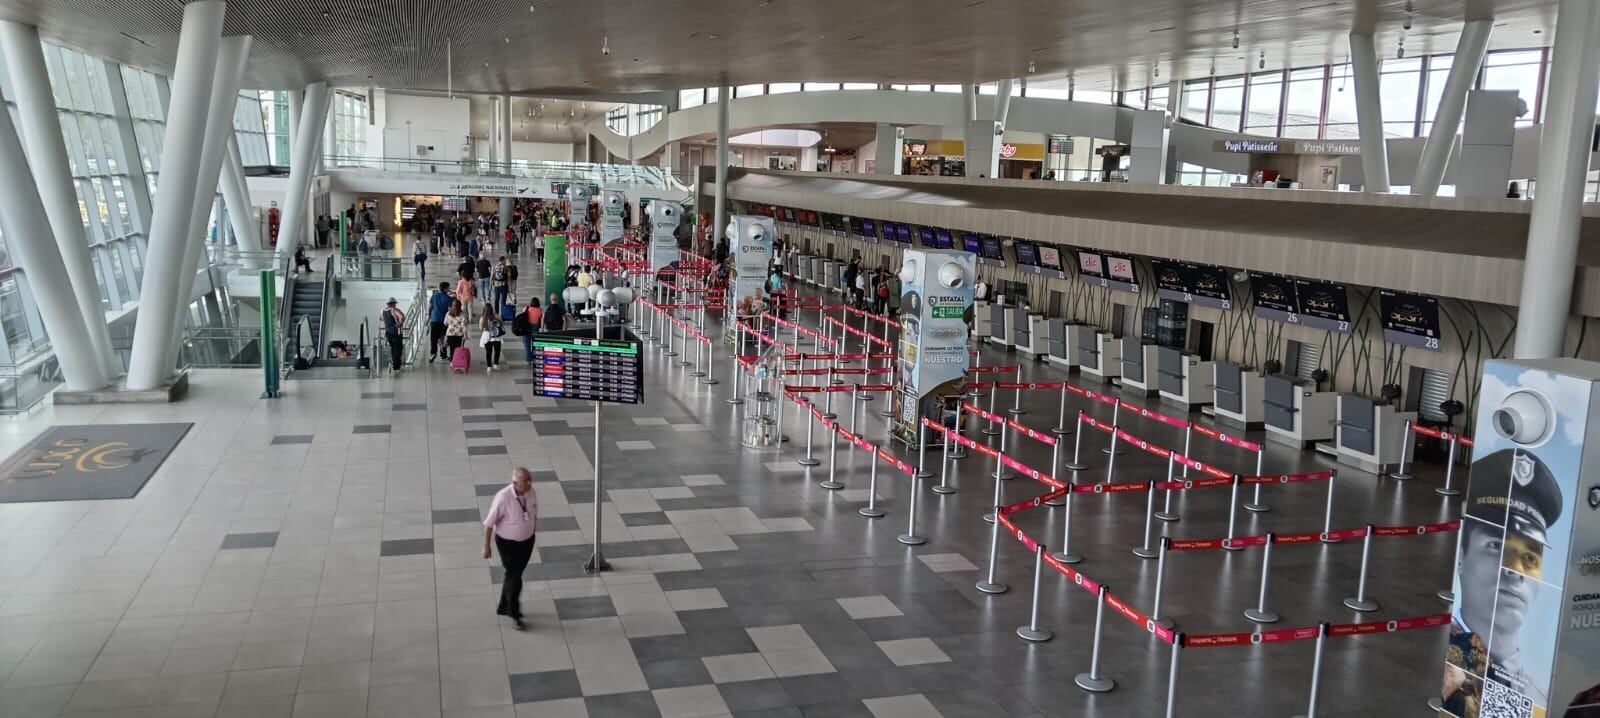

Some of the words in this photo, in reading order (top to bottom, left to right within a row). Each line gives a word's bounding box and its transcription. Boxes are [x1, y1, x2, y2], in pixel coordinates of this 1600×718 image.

[1225, 140, 1241, 152] Pupi
[1303, 143, 1325, 154] Pupi
[1085, 257, 1097, 267] clic
[1114, 262, 1127, 273] clic
[1183, 292, 1193, 303] 24
[1221, 299, 1231, 310] 25
[945, 307, 964, 315] SALIDA
[1287, 312, 1298, 324] 26
[1337, 320, 1349, 332] 27
[1424, 336, 1439, 349] 28
